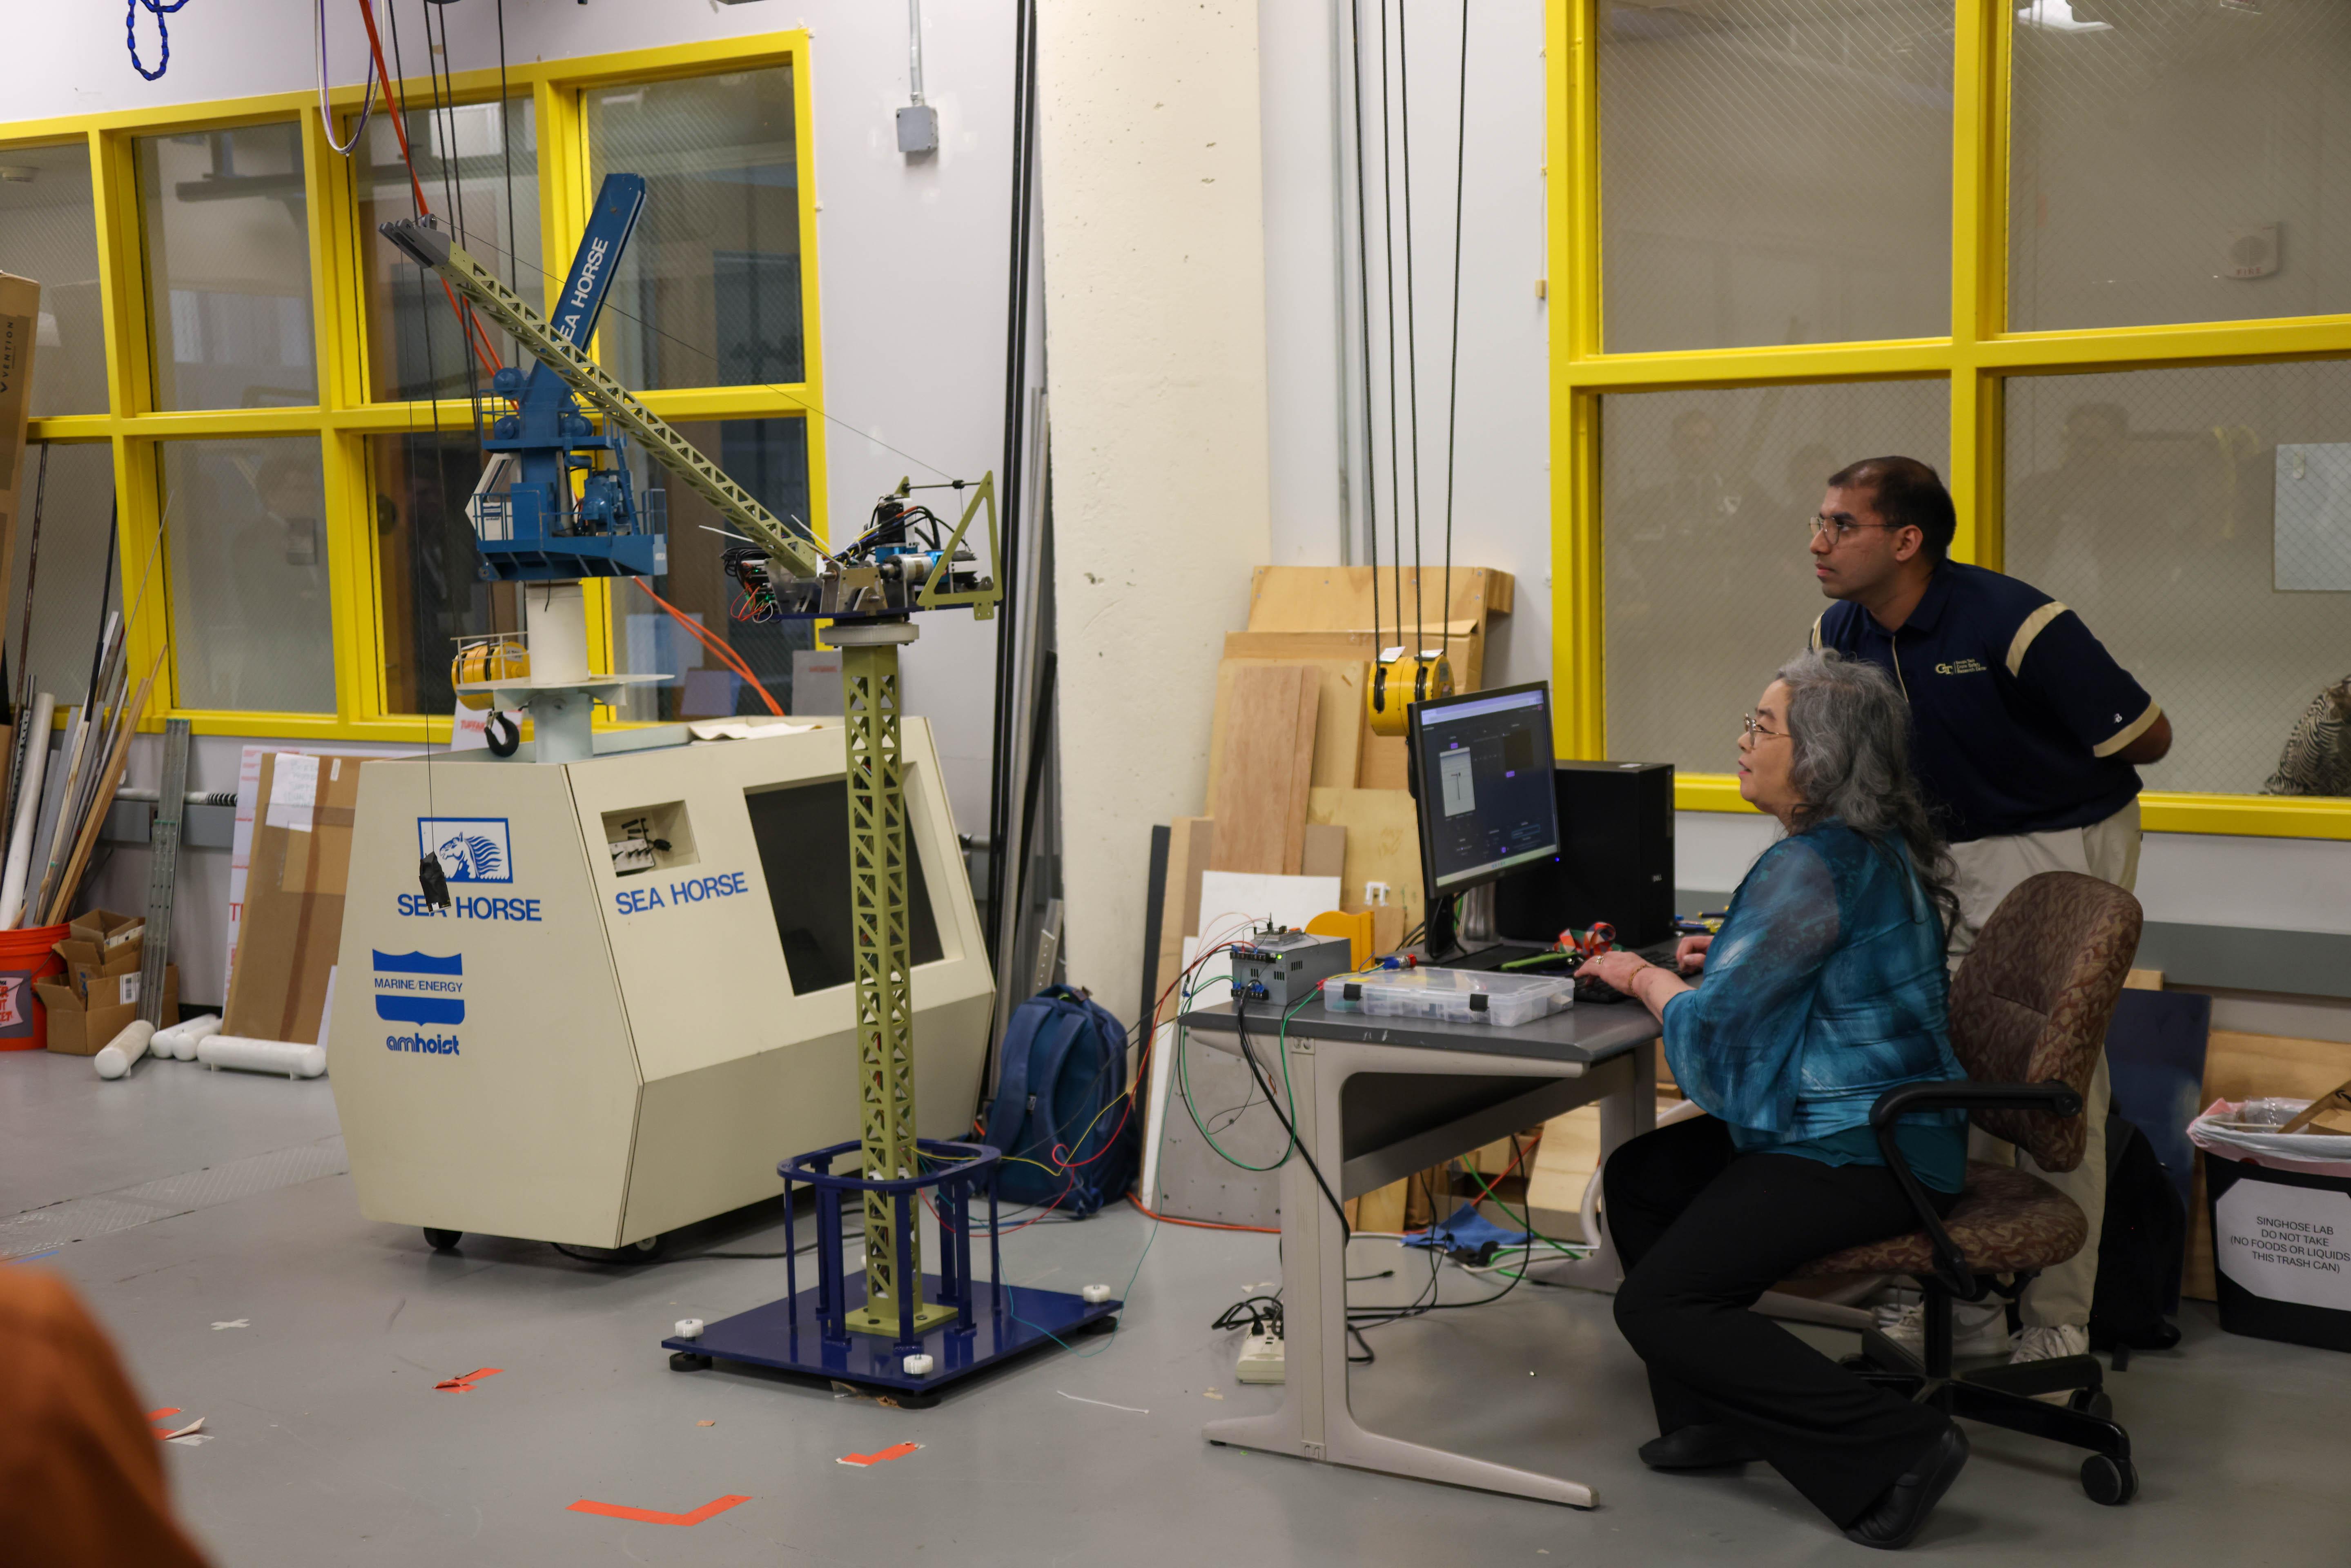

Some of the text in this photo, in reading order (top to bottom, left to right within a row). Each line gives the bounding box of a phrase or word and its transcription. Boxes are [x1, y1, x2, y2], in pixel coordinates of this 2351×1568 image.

[557, 236, 608, 342] EA HORSE
[615, 872, 748, 915] SEA HORSE
[456, 896, 542, 922] HORSE
[386, 1032, 460, 1056] amhoist
[2257, 1216, 2334, 1235] SINGHOSE LAB
[2261, 1229, 2329, 1247] DO NOT TAKE
[2231, 1235, 2351, 1262] (NO FOODS OR LIQUIDS
[2252, 1251, 2340, 1274] THIS TRASH CAN)
